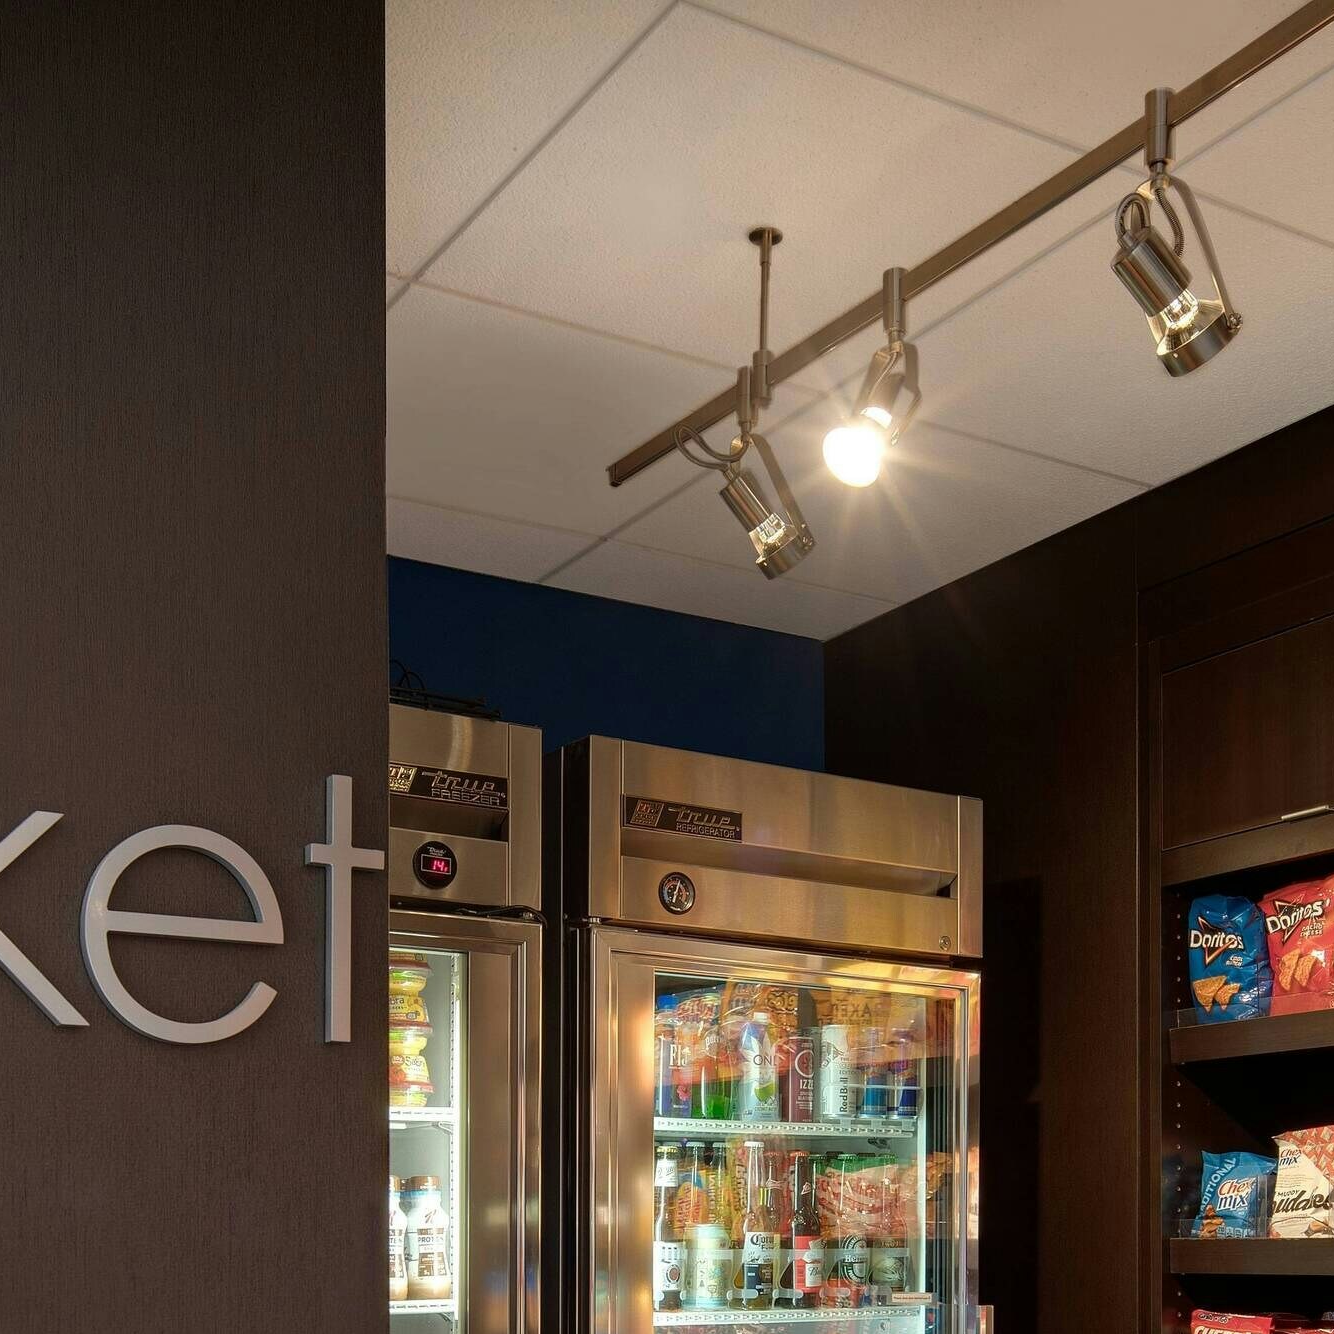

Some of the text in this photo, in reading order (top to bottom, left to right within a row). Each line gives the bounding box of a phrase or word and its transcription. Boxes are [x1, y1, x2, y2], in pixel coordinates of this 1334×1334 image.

[431, 788, 500, 806] FREEZER
[676, 822, 736, 839] REFRIGERATOR
[1266, 899, 1324, 934] Doritos
[1190, 930, 1244, 949] Doritos
[389, 995, 405, 1005] bra
[1280, 1148, 1302, 1158] Chex
[1218, 1179, 1255, 1197] Chex
[1217, 1193, 1249, 1212] mix
